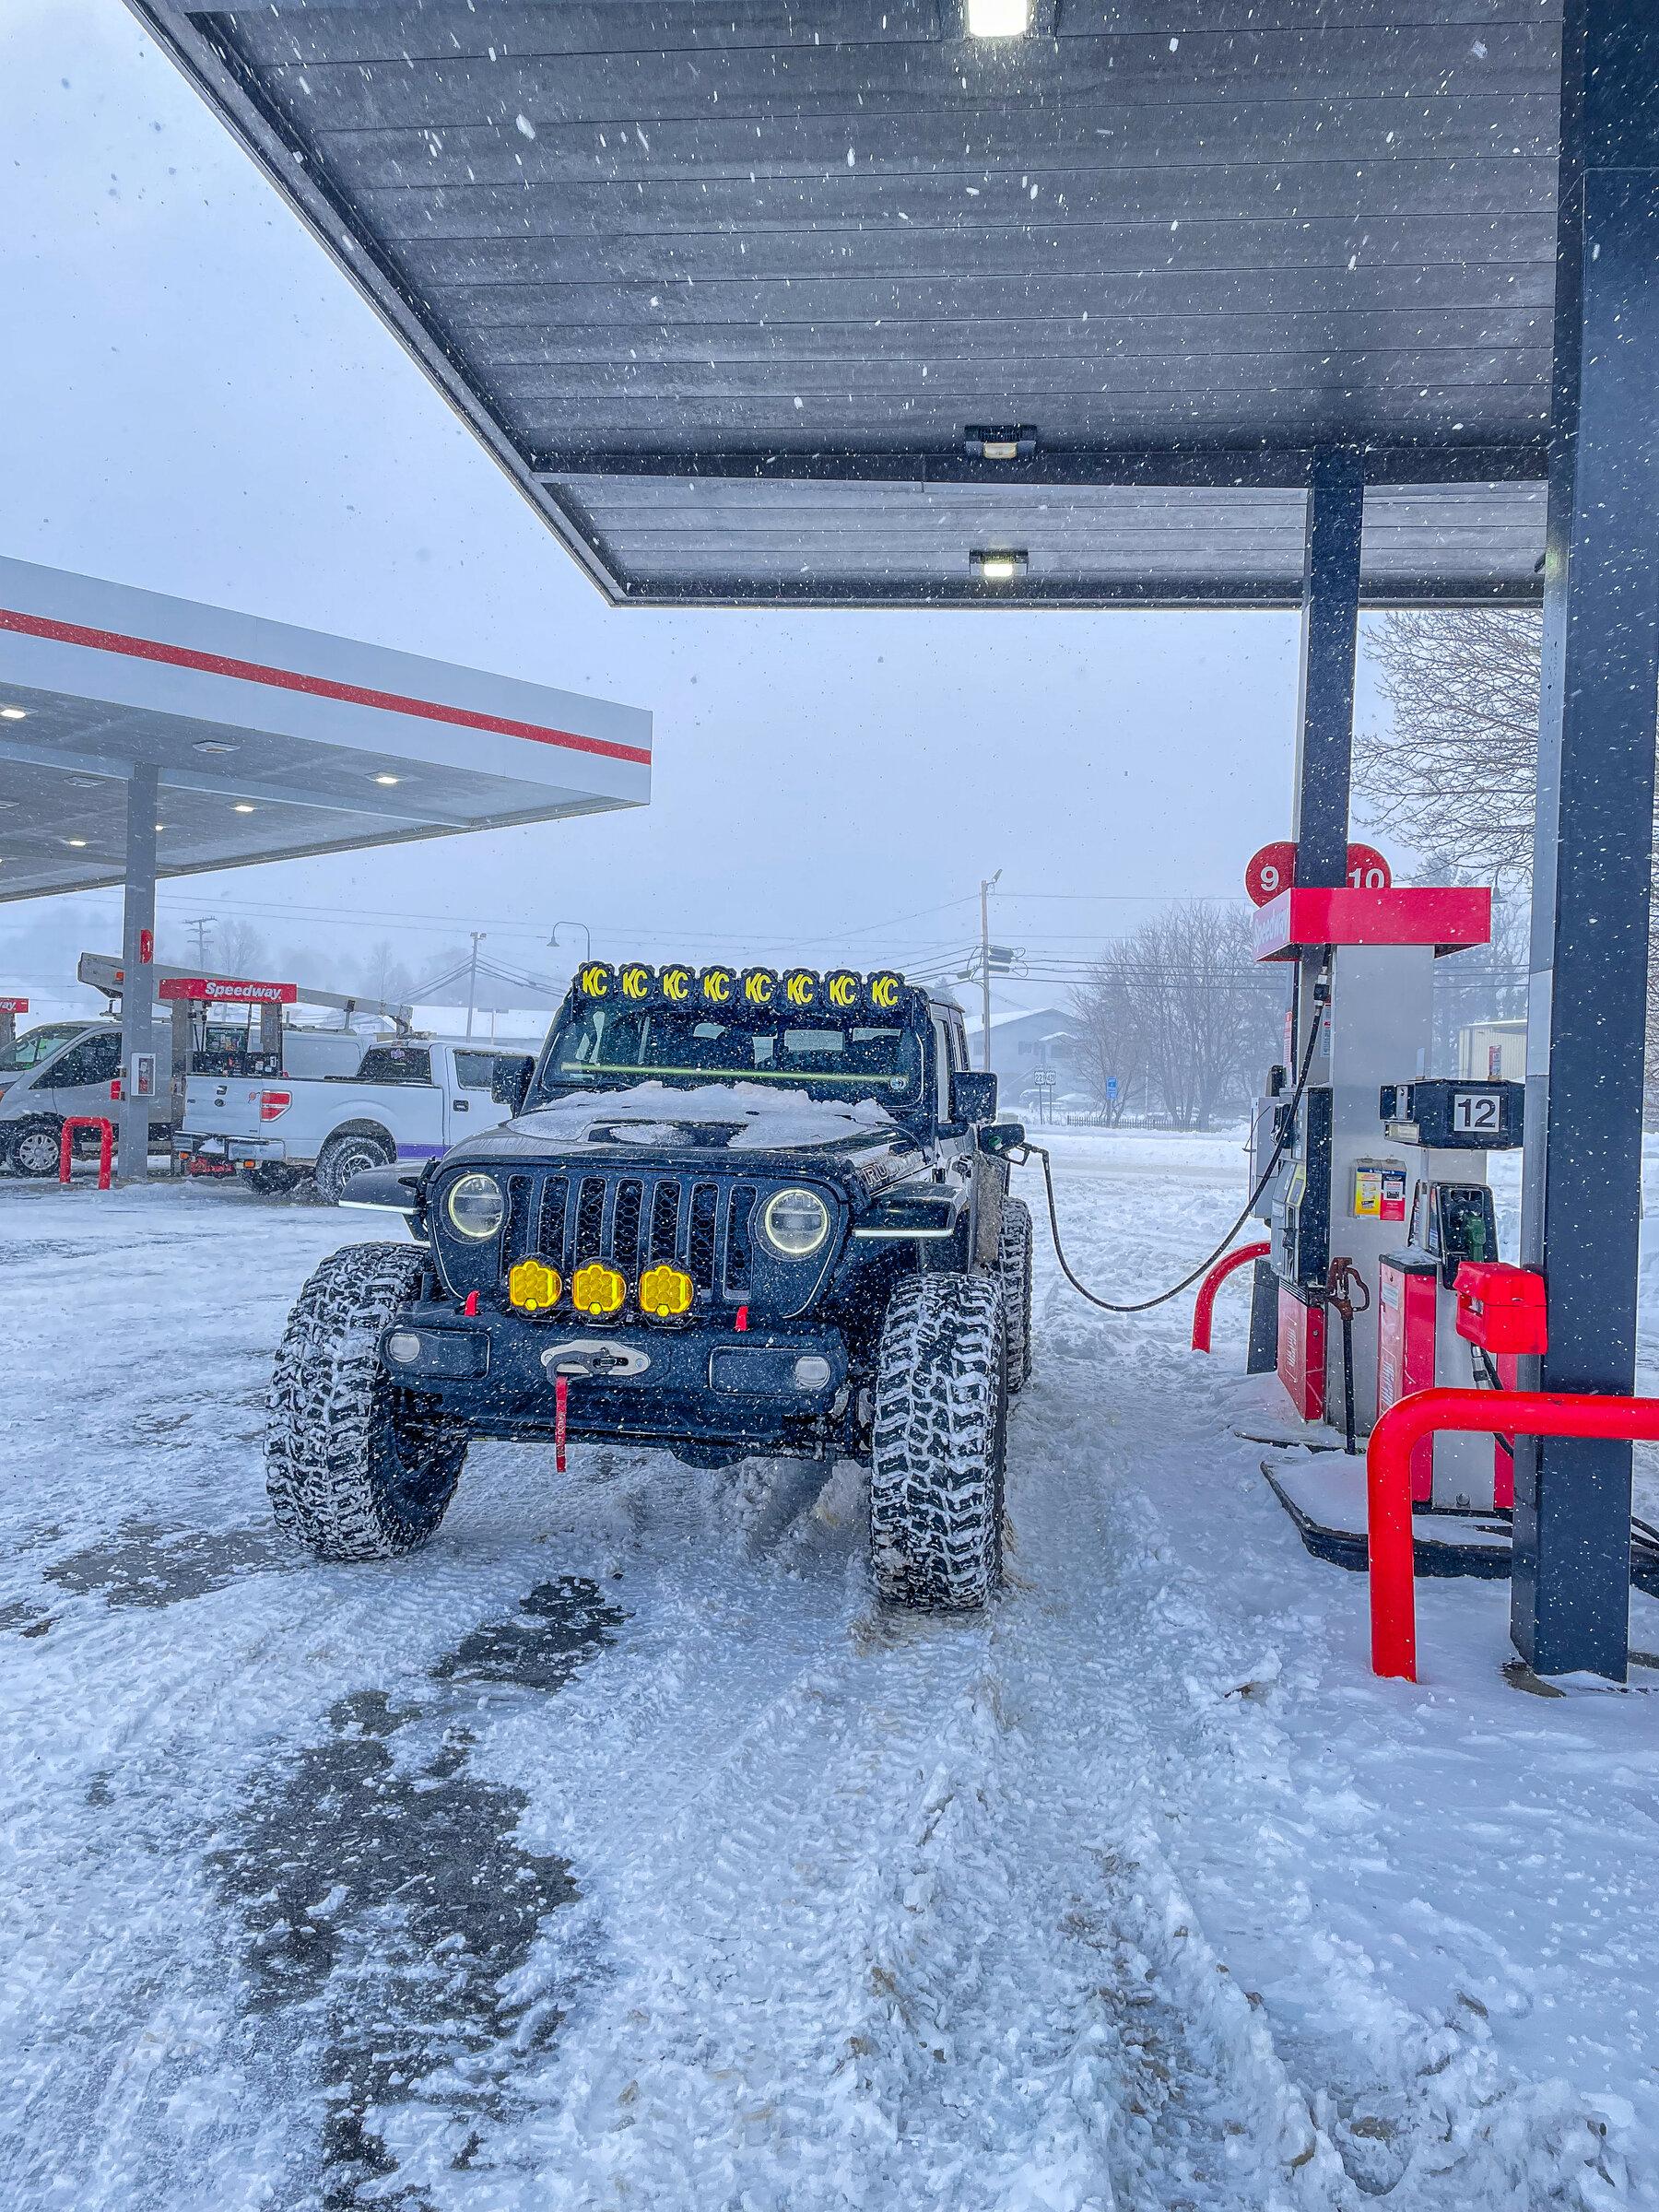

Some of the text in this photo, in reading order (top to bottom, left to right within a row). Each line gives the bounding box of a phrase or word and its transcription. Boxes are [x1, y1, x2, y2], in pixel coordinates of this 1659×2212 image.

[1260, 865, 1279, 891] 9
[1348, 867, 1385, 888] 10
[582, 966, 607, 997] KC
[622, 968, 648, 999] KC
[663, 970, 688, 1001] KC
[703, 971, 730, 1002] KC
[745, 972, 771, 1004] KC
[787, 973, 813, 1005] KC
[830, 975, 855, 1006] KC
[872, 976, 899, 1007] KC
[1458, 1098, 1496, 1127] 12
